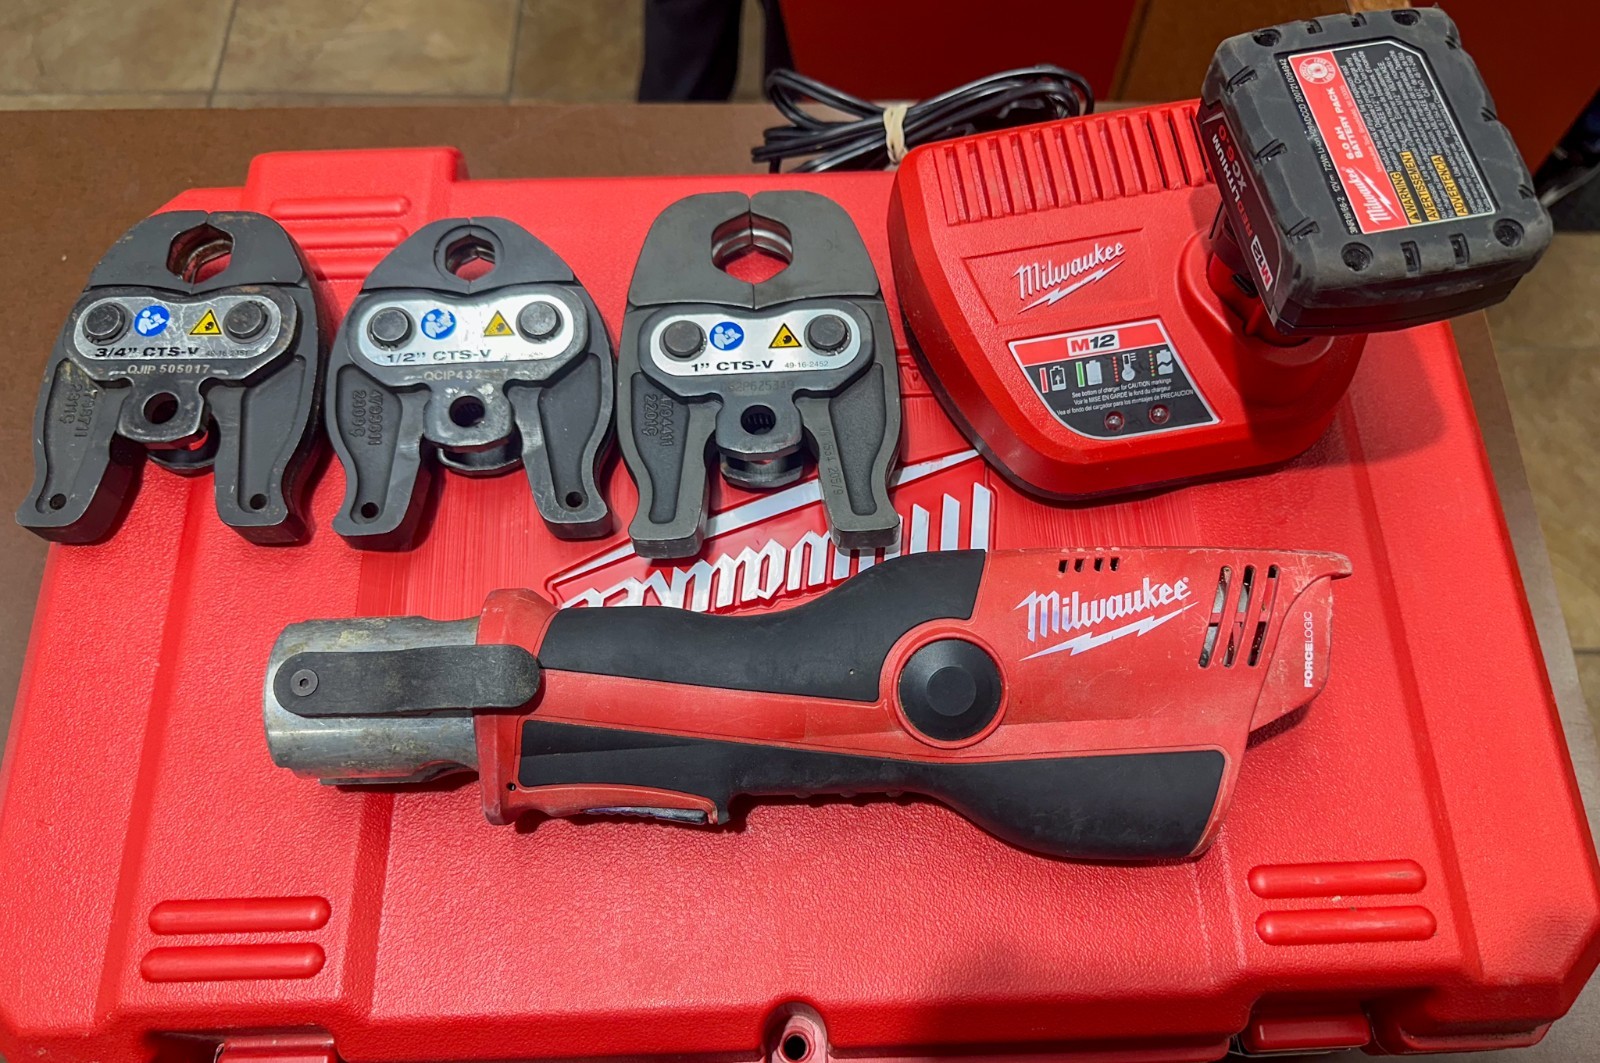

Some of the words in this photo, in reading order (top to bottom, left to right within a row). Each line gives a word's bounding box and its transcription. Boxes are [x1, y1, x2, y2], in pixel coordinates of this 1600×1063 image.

[1327, 86, 1344, 113] PACK
[1334, 126, 1346, 140] AH
[1339, 116, 1363, 158] BATTERY
[1218, 124, 1248, 192] XC6.0
[1341, 143, 1354, 159] 6.0
[1348, 168, 1392, 225] Milwaukee
[1391, 172, 1416, 212] WARNING
[1400, 152, 1438, 219] AVERTISSEMENT
[1432, 156, 1466, 214] ADVERTENCIA
[1012, 240, 1126, 300] Milwaukee
[1252, 241, 1272, 287] M12
[142, 346, 200, 357] CTS-V
[432, 350, 492, 361] CTS-V
[1071, 334, 1115, 353] M12
[127, 364, 156, 374] QJIP
[159, 364, 210, 374] 505017
[716, 360, 774, 371] CTS-V
[784, 360, 829, 368] 49-16-2452
[1110, 391, 1128, 400] GARDE
[1128, 380, 1150, 389] CAUTION
[1013, 576, 1192, 642] Milwaukee
[1304, 611, 1313, 688] FORCELOGIC
